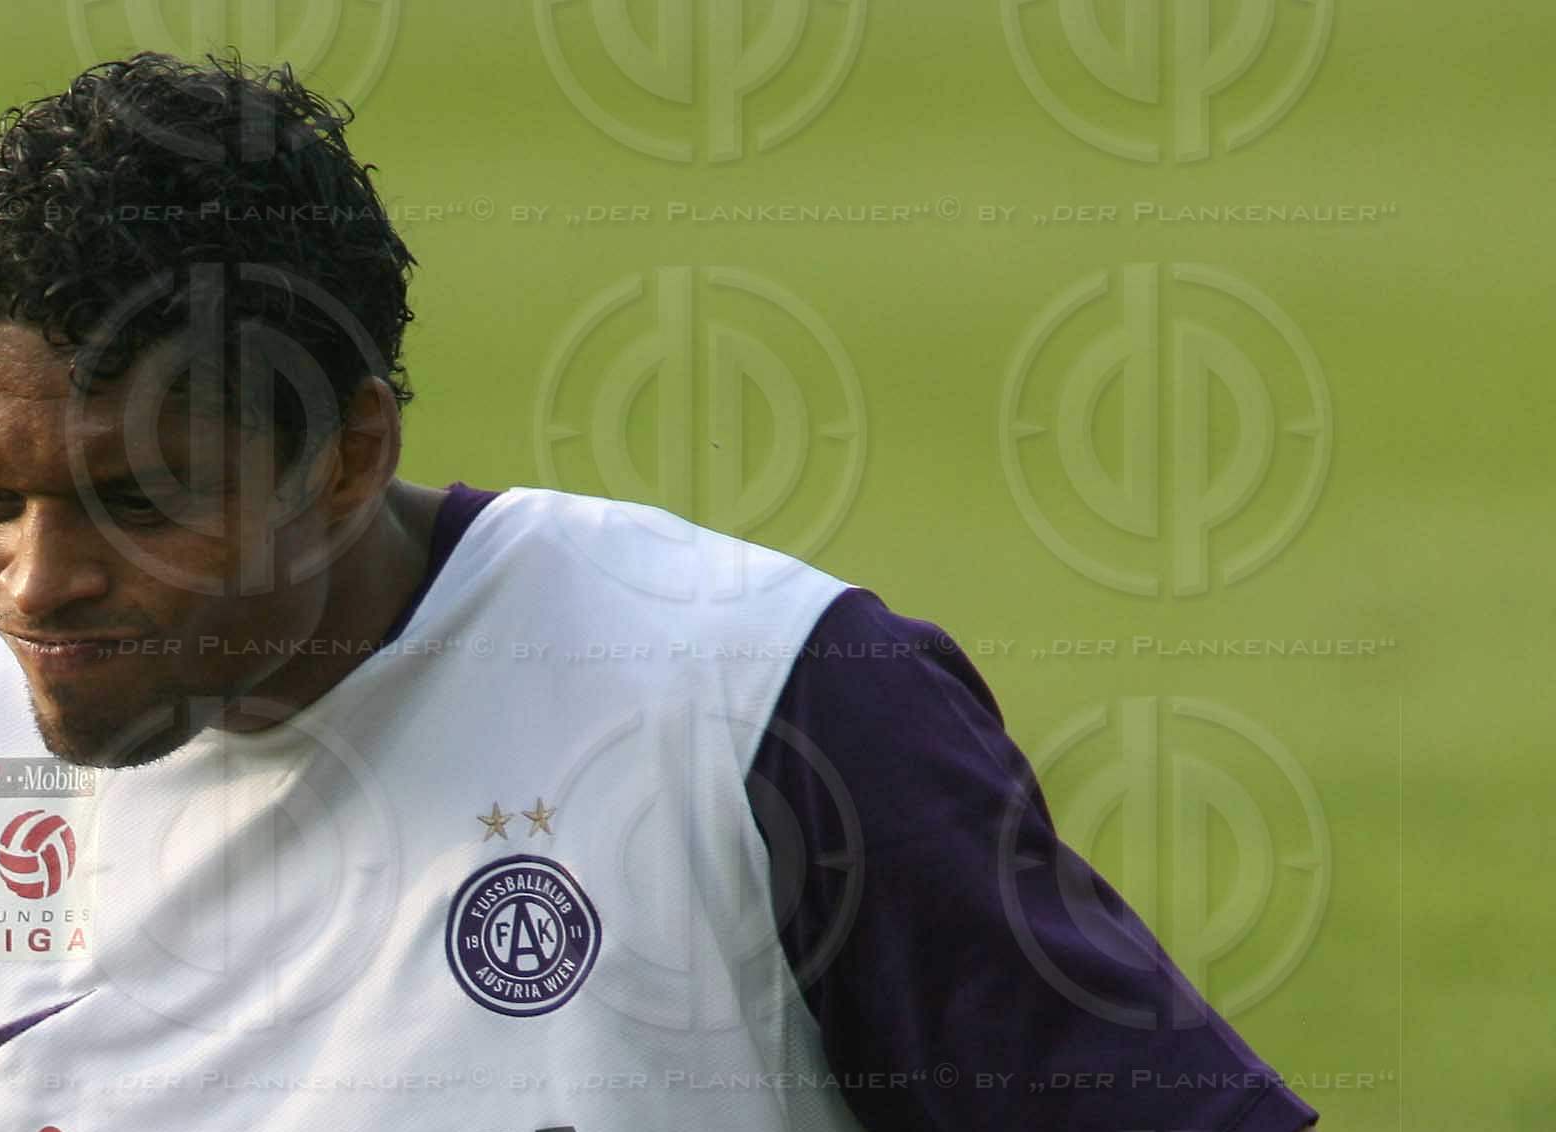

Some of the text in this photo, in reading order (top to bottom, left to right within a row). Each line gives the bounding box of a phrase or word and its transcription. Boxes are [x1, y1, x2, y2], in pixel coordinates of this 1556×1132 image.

[471, 874, 573, 919] FUSSBALLKLUB
[465, 935, 480, 950] 19
[475, 958, 577, 999] AUSTRIA WIEN
